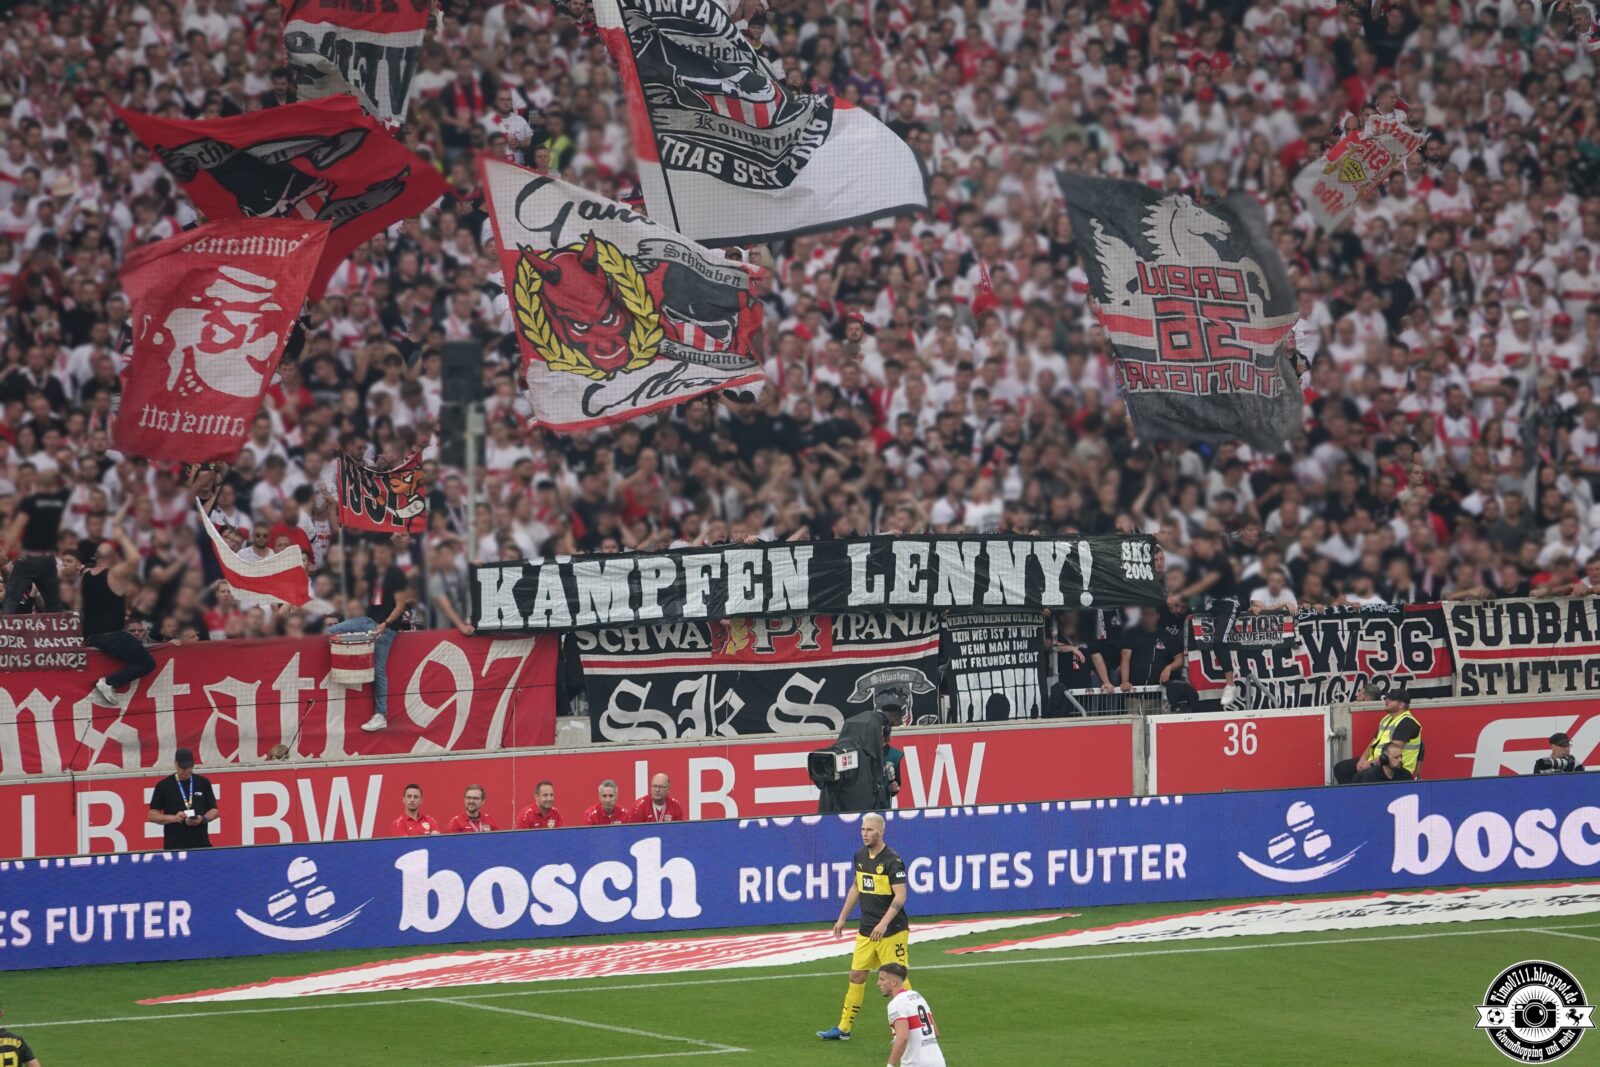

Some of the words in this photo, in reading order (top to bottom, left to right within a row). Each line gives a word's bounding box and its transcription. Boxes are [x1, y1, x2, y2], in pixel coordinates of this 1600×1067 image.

[661, 136, 724, 174] TRAS
[663, 244, 742, 287] Schwaben
[662, 342, 748, 366] Kompanie
[1121, 541, 1152, 562] SKS
[476, 545, 814, 630] KÄMPFEN
[847, 540, 1094, 607] LENNY!
[52, 616, 81, 631] IST
[577, 622, 711, 652] SCHWA
[952, 630, 970, 643] KEIN
[972, 629, 988, 641] WEG
[991, 628, 1004, 640] IST
[1008, 627, 1018, 639] ZU
[1200, 615, 1284, 634] STION
[1451, 600, 1600, 646] SÜDBA
[0, 634, 27, 648] DER
[960, 643, 986, 655] WENN
[989, 641, 1010, 653] MAN
[1013, 640, 1028, 651] IHN
[0, 653, 31, 667] UMS
[35, 652, 87, 668] GANZE
[951, 658, 967, 670] MIT
[970, 654, 1017, 668] FREUNDEN
[1019, 652, 1039, 663] GEHT
[404, 637, 536, 753] 97
[1223, 721, 1258, 757] 36
[394, 837, 702, 933] bosch
[739, 861, 853, 903] RICHT
[909, 851, 1033, 894] GUTES
[1047, 843, 1187, 886] FUTTER
[46, 900, 192, 945] FUTTER
[895, 943, 904, 957] 25
[917, 1004, 933, 1036] 9
